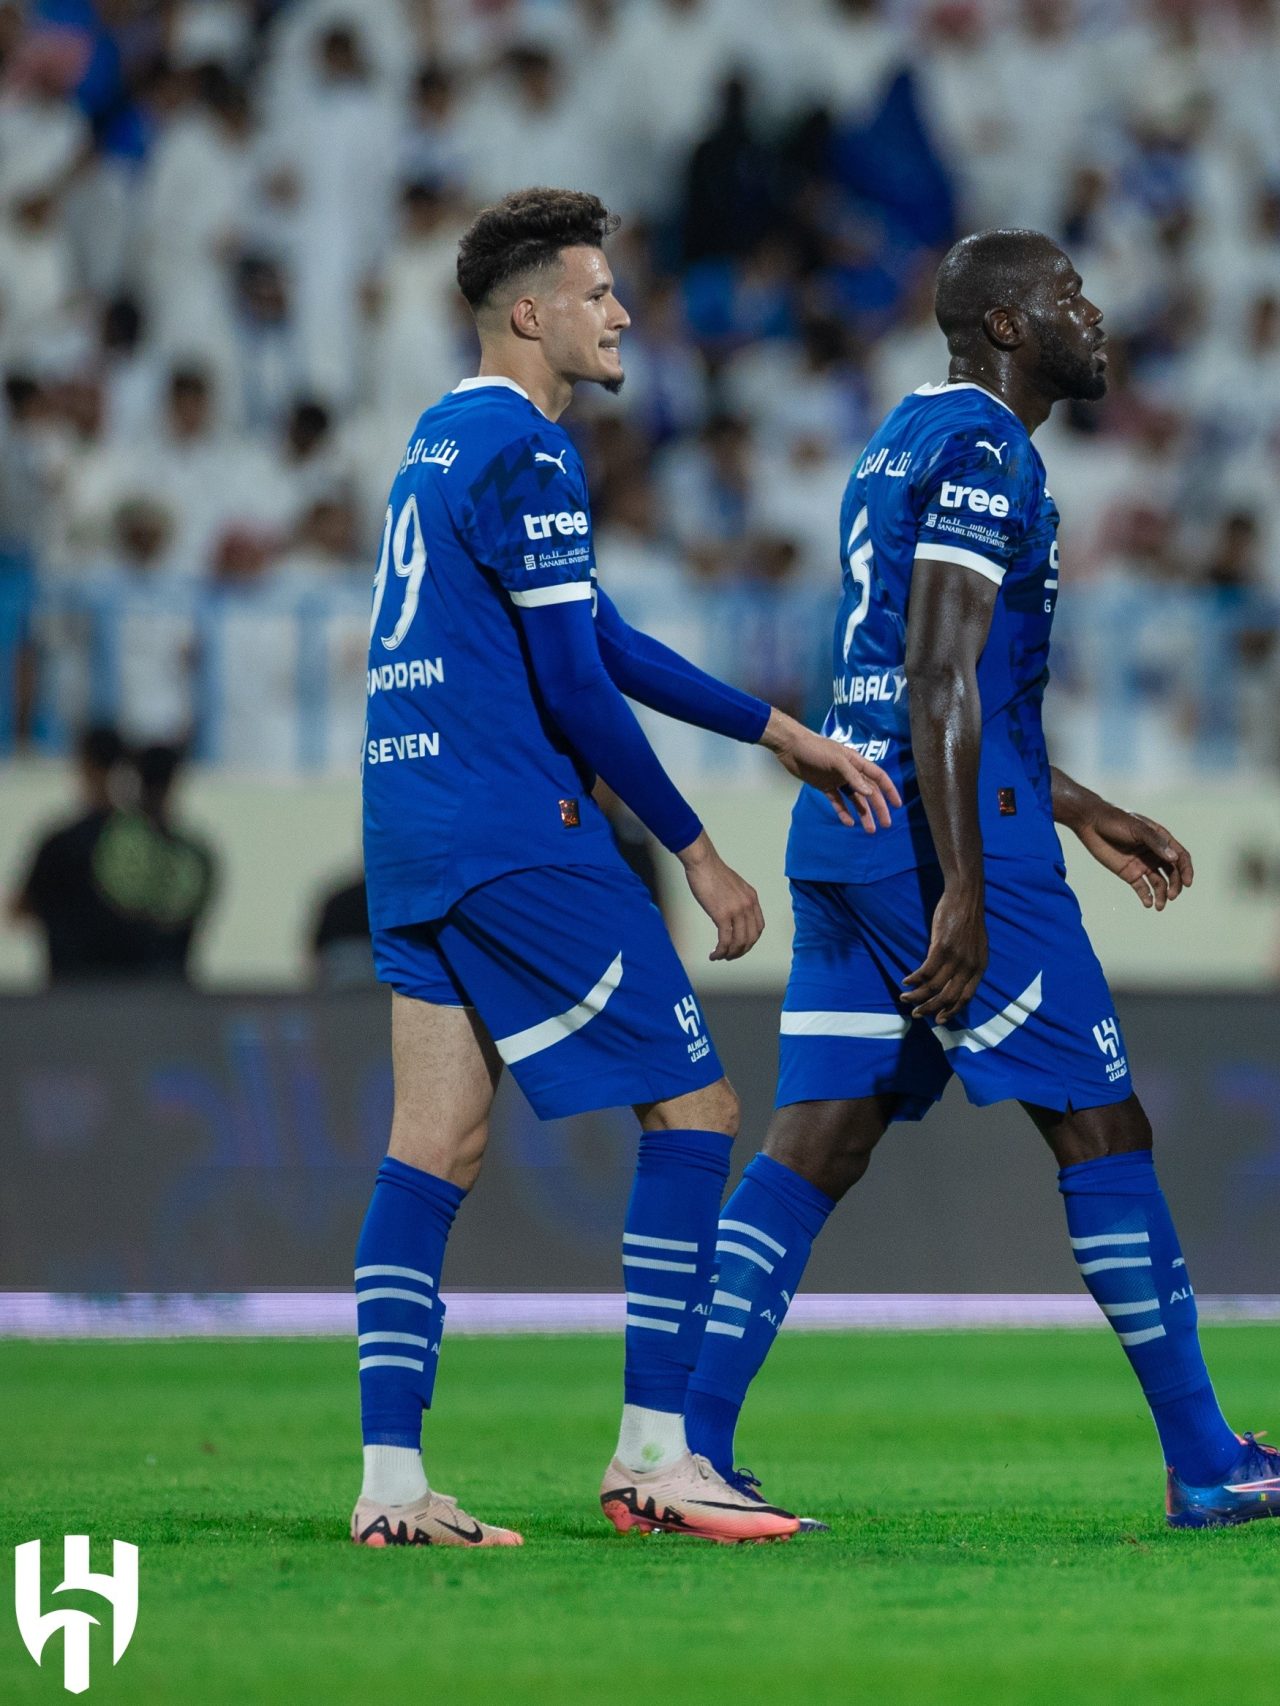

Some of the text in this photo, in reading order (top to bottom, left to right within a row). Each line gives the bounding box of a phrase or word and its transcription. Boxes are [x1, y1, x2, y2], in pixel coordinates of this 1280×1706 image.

[940, 481, 1010, 518] tree
[522, 511, 589, 540] tree
[367, 732, 440, 765] SEVEN
